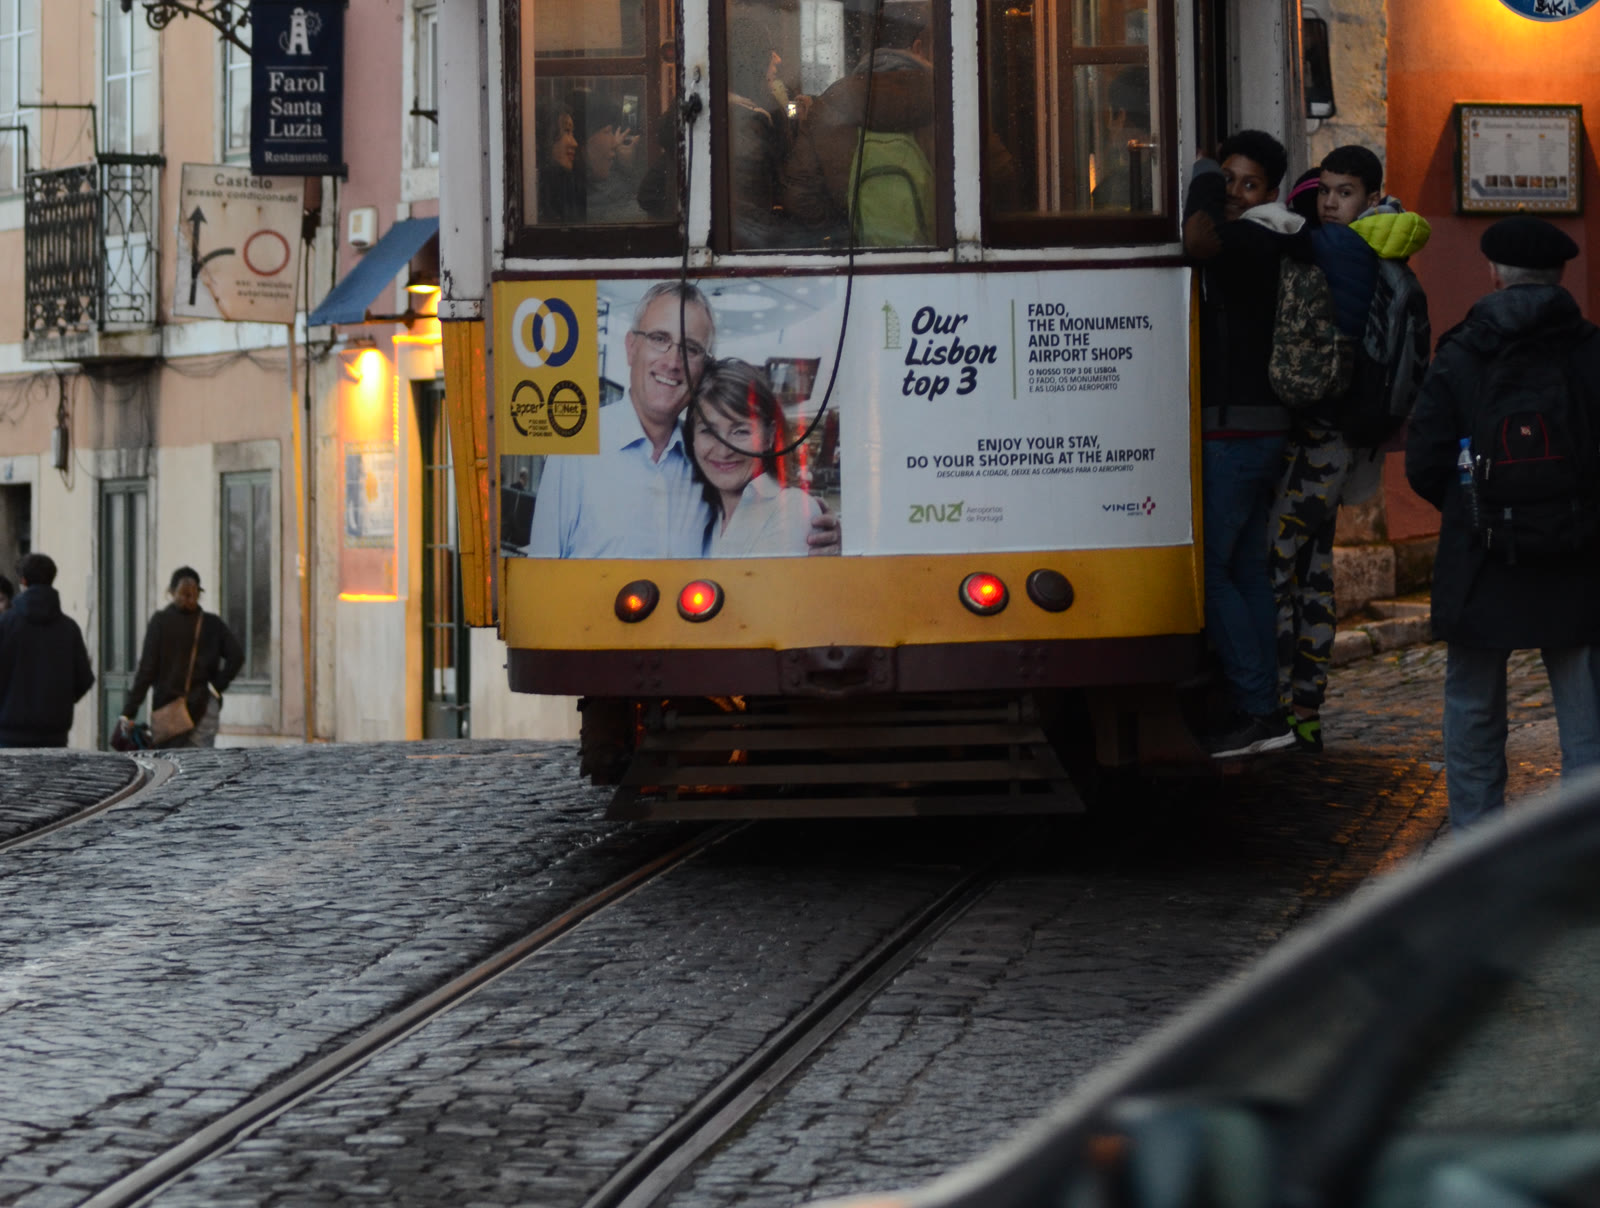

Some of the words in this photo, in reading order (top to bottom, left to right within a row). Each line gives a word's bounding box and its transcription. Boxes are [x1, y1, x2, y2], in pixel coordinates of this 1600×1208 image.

[269, 72, 325, 92] Farol
[270, 96, 322, 116] Santa
[269, 118, 322, 137] Luzia
[264, 151, 328, 163] Restaurante
[214, 173, 273, 190] Castelo
[1028, 302, 1069, 318] FADO,
[912, 305, 969, 335] Our
[1028, 318, 1056, 332] THE
[1060, 315, 1153, 331] MONUMENTS,
[1028, 333, 1060, 348] AND
[1064, 332, 1090, 346] THE
[905, 336, 997, 366] Lisbon
[1028, 348, 1088, 363] AIRPORT
[1091, 346, 1133, 361] SHOPS
[1036, 368, 1061, 376] NOSSO
[1063, 367, 1076, 375] TOP
[1094, 366, 1117, 374] LISBOA
[1058, 376, 1068, 384] OS
[1070, 374, 1120, 383] MONUMENTOS
[902, 369, 950, 402] top
[956, 366, 978, 396] 3
[1046, 384, 1065, 393] LOJAS
[1079, 383, 1118, 391] AEROPORTO
[977, 438, 1022, 453] ENJOY
[1026, 437, 1064, 450] YOUR
[1068, 435, 1100, 449] STAY,
[907, 456, 929, 469] DO
[933, 455, 974, 468] YOUR
[979, 452, 1054, 467] SHOPPING
[1058, 451, 1074, 464] AT
[1077, 450, 1102, 463] THE
[1105, 448, 1155, 462] AIRPORT
[937, 470, 974, 478] DESCUBRA
[1011, 468, 1031, 476] DEIXE
[1042, 467, 1074, 475] COMPRAS
[1098, 464, 1134, 473] AEROPORTO
[1102, 503, 1140, 512] VINCI
